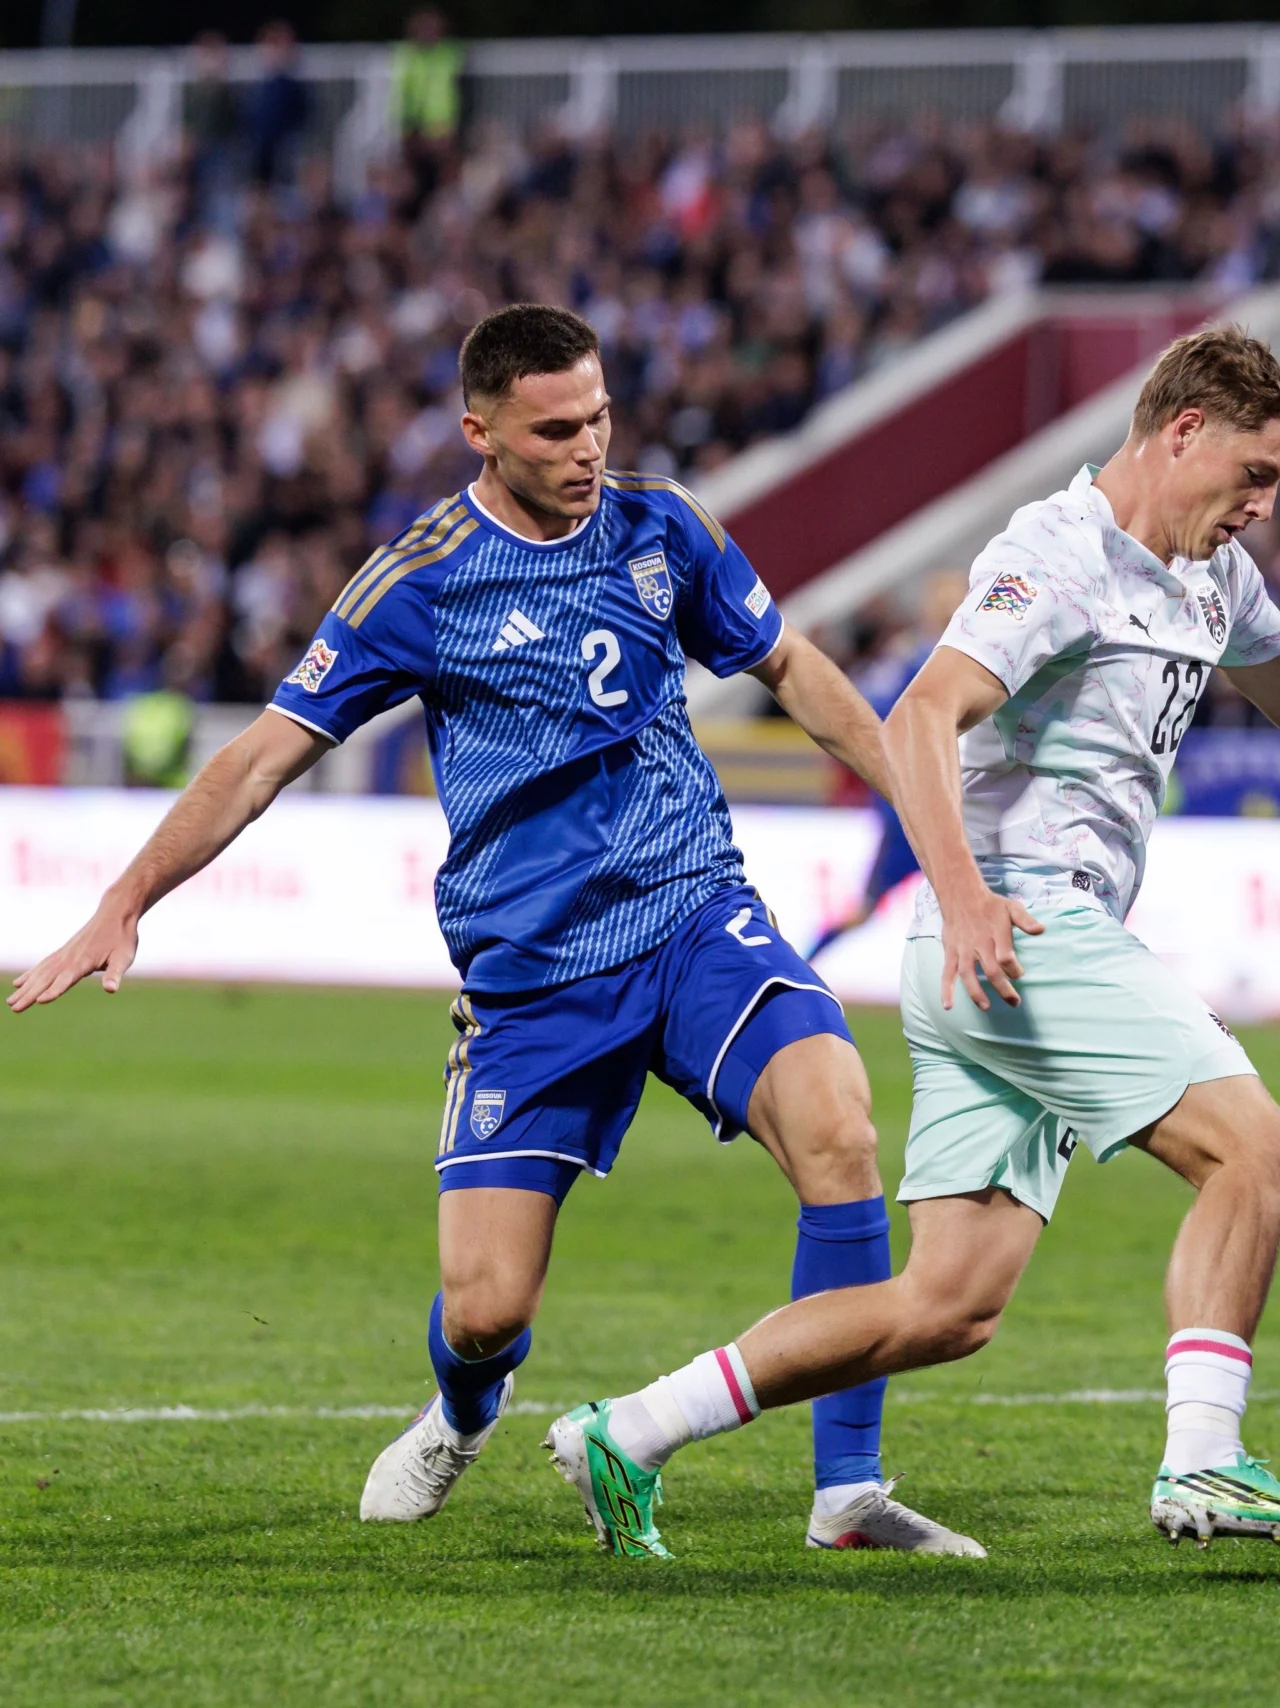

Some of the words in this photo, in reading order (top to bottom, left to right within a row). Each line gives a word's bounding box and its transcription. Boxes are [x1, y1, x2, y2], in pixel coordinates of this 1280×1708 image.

[632, 557, 662, 571] KOSOVA
[581, 629, 629, 707] 2
[1151, 660, 1203, 755] 22
[725, 907, 772, 947] 2
